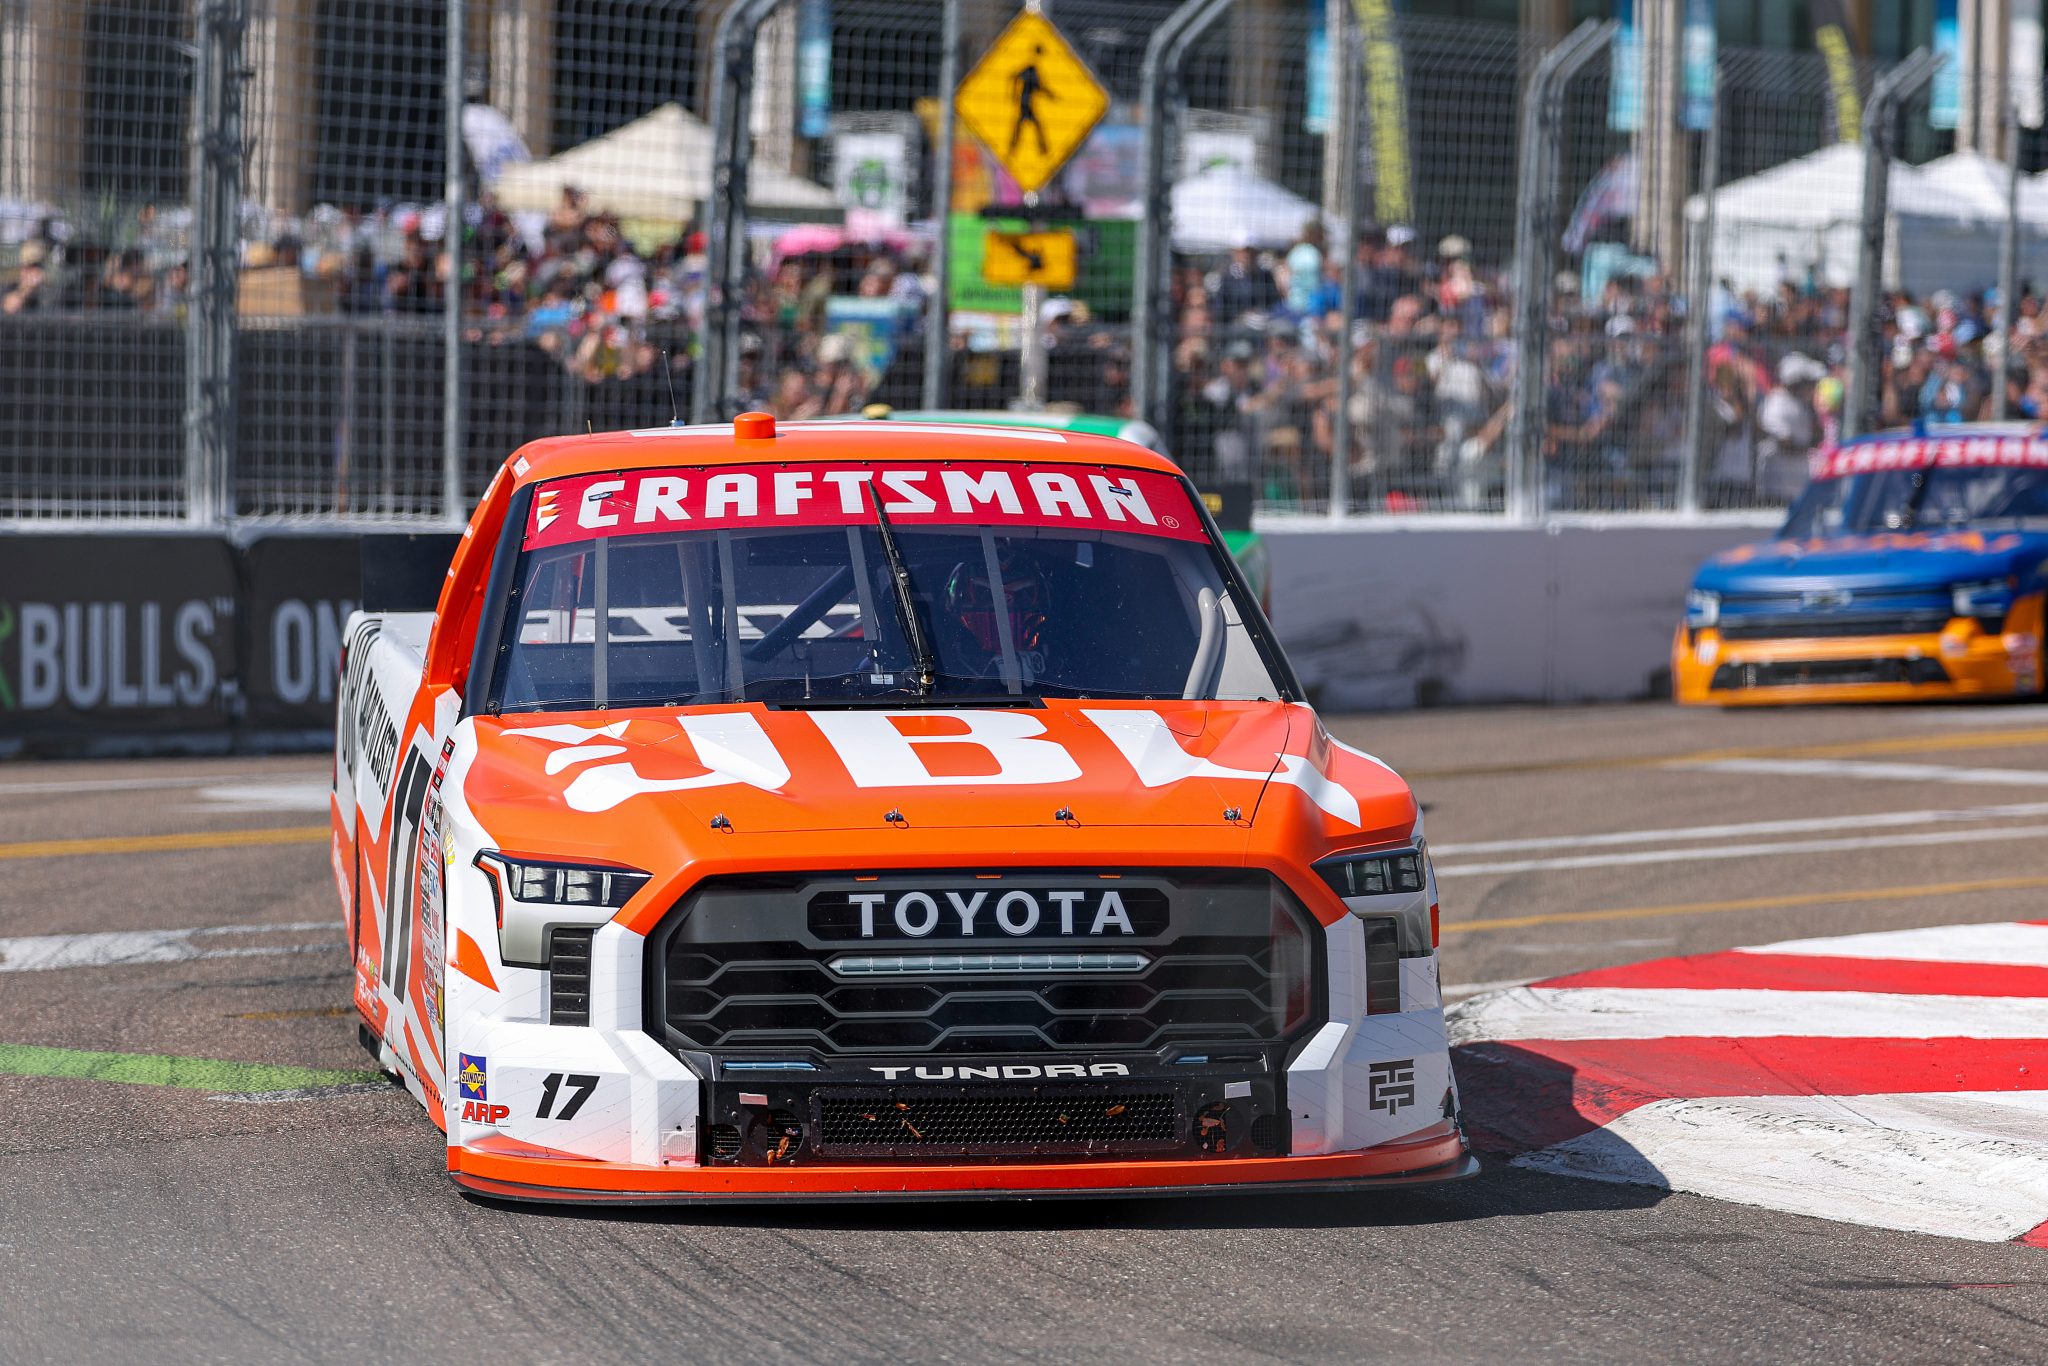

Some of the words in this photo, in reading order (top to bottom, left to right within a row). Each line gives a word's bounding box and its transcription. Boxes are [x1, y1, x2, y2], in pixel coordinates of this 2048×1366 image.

[577, 470, 1158, 530] CRAFTSMAN
[20, 600, 216, 710] BULLS
[560, 706, 1362, 828] JBL
[848, 890, 1135, 938] TOYOTA
[461, 1070, 486, 1086] SUNOCO
[870, 1062, 1131, 1081] TUNDRA
[462, 1100, 510, 1125] ARP
[536, 1072, 601, 1121] 17
